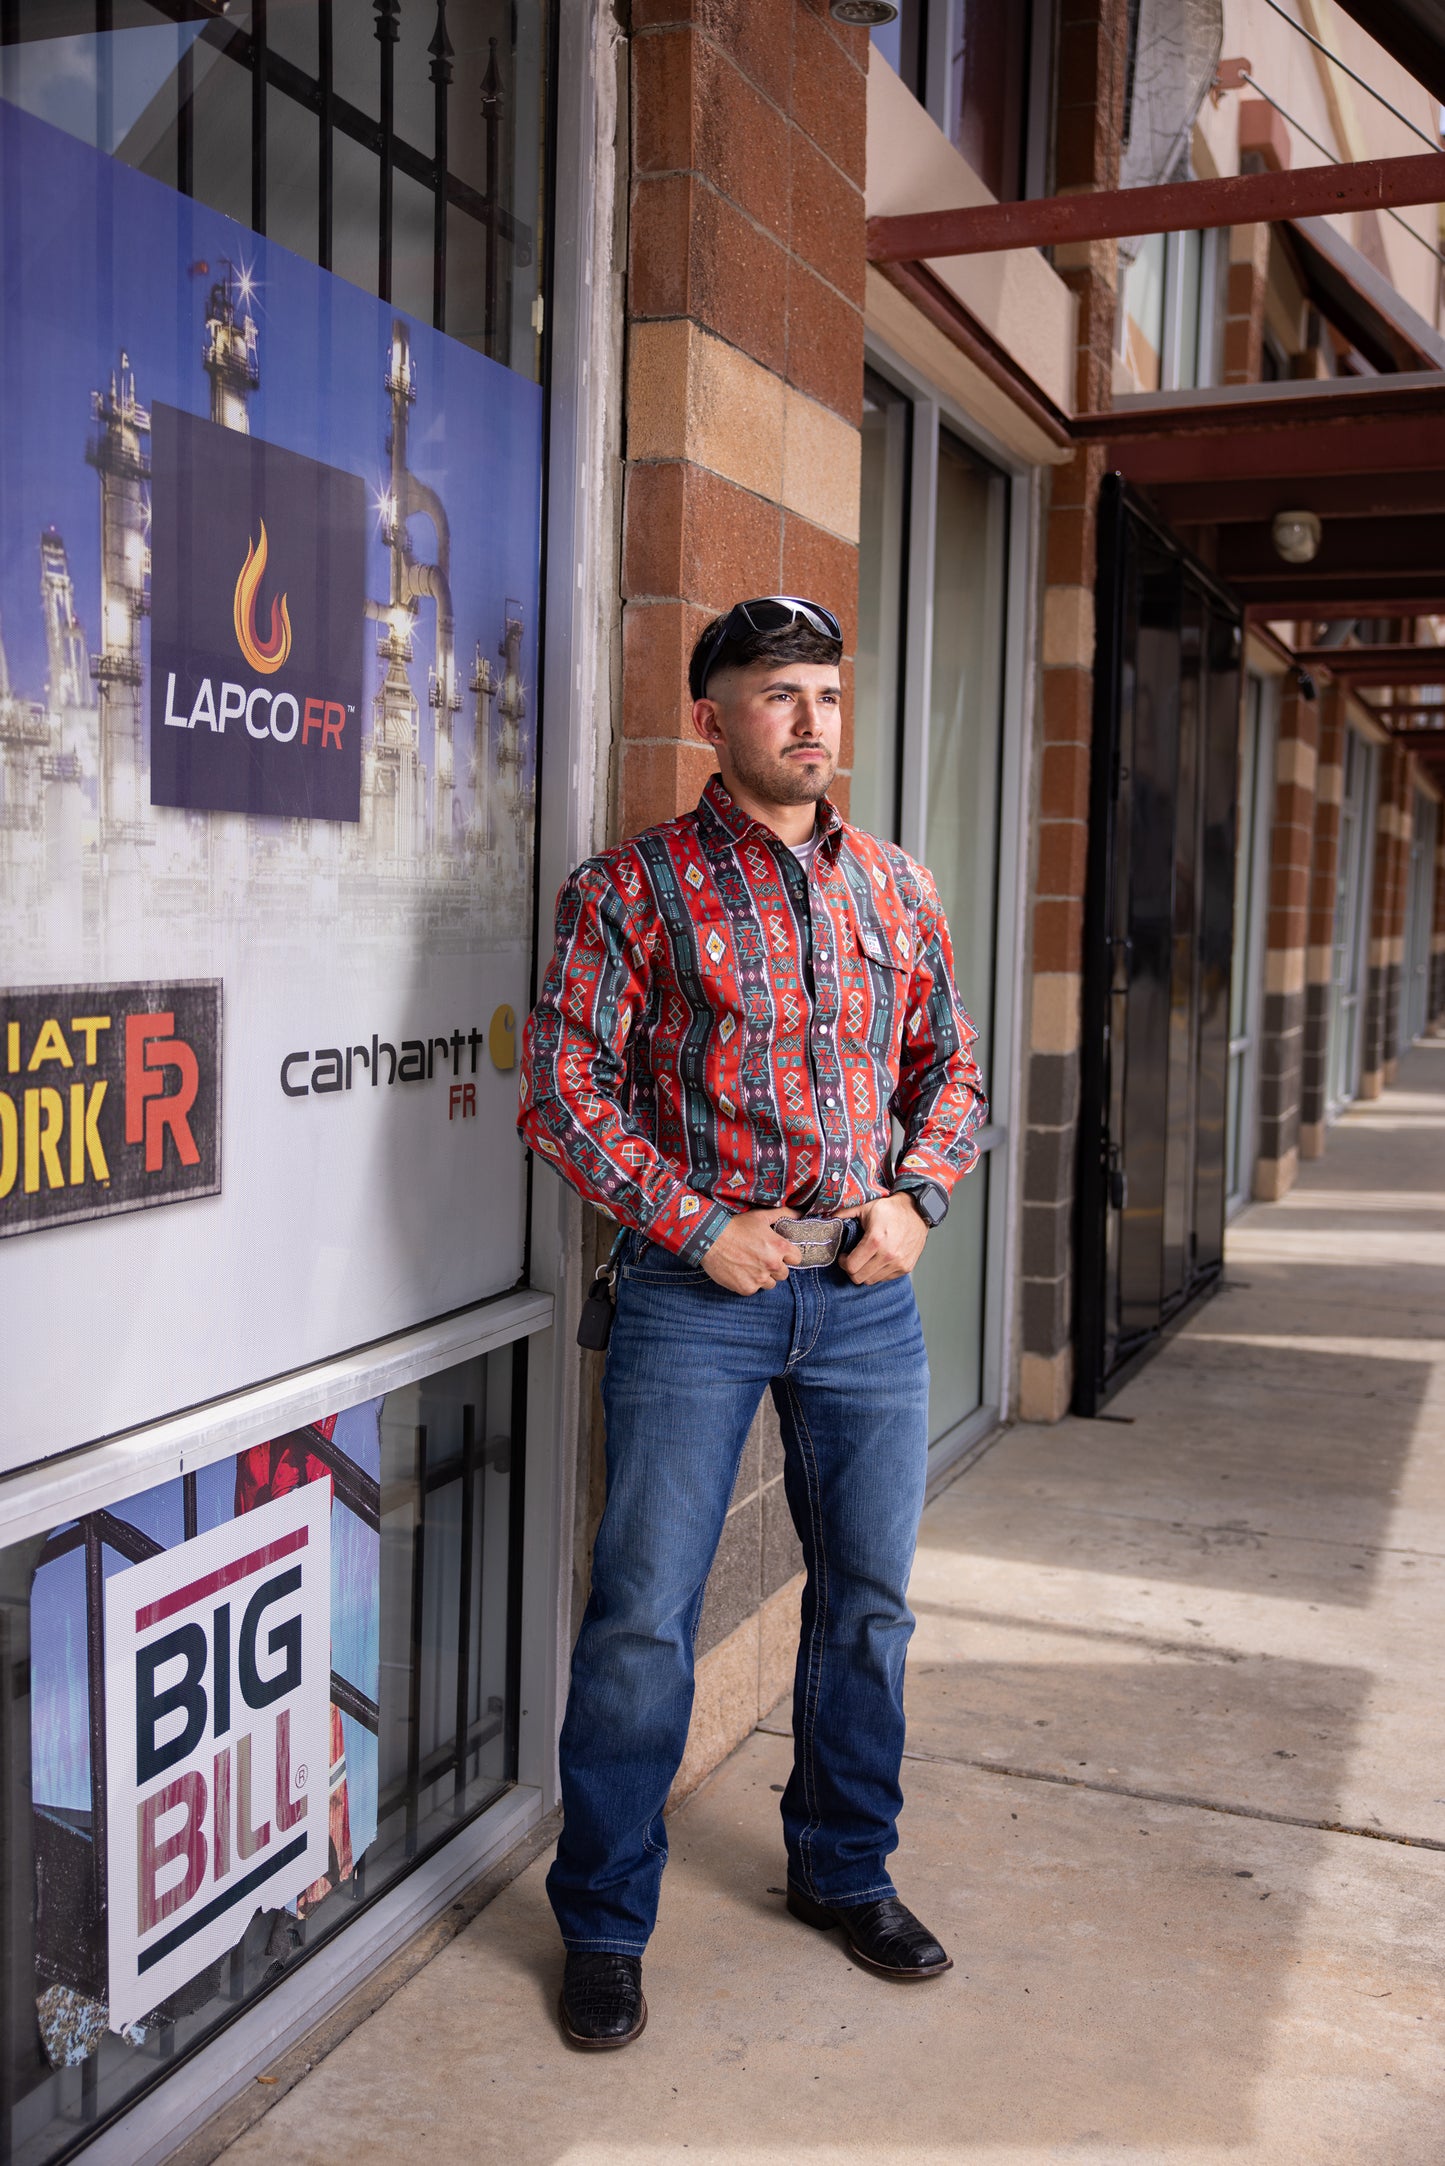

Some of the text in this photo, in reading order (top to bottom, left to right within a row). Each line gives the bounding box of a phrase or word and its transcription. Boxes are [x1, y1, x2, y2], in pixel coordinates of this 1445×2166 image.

[125, 1012, 201, 1172] FR
[280, 1027, 483, 1097] carhartt
[448, 1082, 477, 1121] FR
[136, 1563, 302, 1787] BIG
[136, 1708, 308, 1937] BILL
